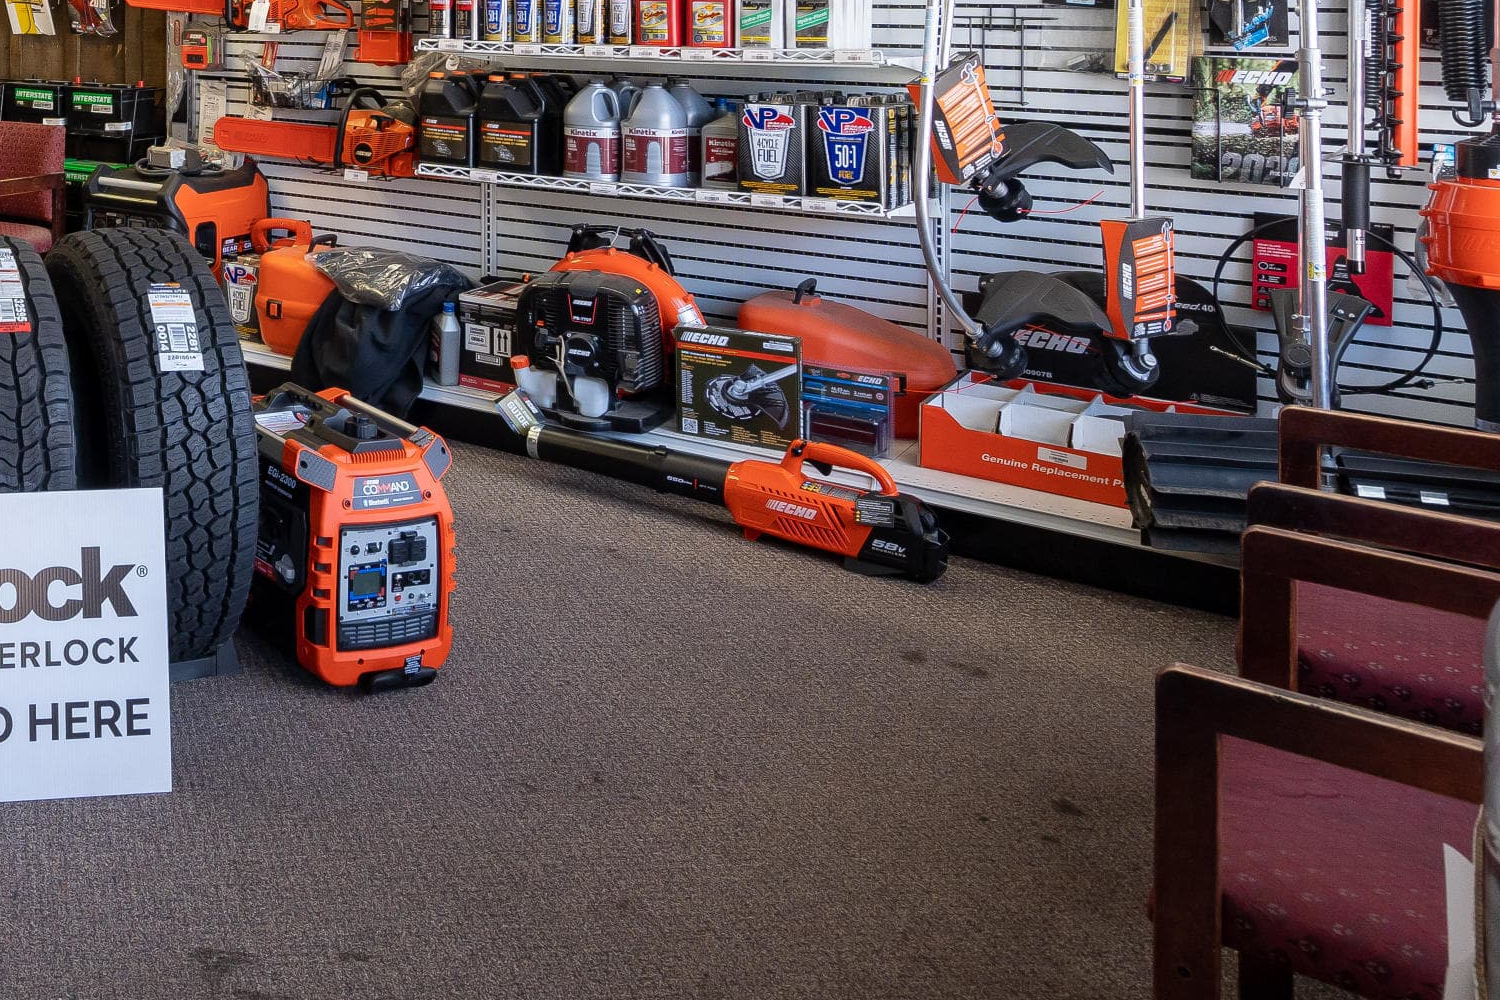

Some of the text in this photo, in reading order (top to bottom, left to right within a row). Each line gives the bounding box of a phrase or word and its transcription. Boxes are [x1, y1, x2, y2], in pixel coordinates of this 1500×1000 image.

[742, 0, 770, 10] Meyer
[798, 0, 827, 11] Meyer
[1230, 70, 1293, 86] ECHO
[15, 90, 52, 100] INTERSTATE
[73, 94, 112, 104] INTERSTATE
[745, 107, 779, 130] VP
[819, 109, 856, 135] VP
[757, 149, 779, 164] FUEL
[835, 144, 857, 169] 50:1
[66, 172, 88, 181] NTERST
[838, 170, 854, 180] FUEL
[226, 266, 248, 285] VP
[1122, 262, 1133, 293] ECHO
[13, 298, 28, 322] 32595
[156, 325, 170, 352] 0014
[186, 325, 199, 353] 2281
[693, 333, 730, 346] ECHO
[1019, 330, 1092, 354] ECHO
[857, 376, 883, 385] ECHO
[506, 401, 530, 429] GUIDE
[981, 453, 1028, 469] Genuine
[1031, 463, 1109, 485] Replacement
[362, 480, 409, 495] COMMAND
[776, 500, 818, 520] ECHO
[28, 697, 151, 742] HERE
